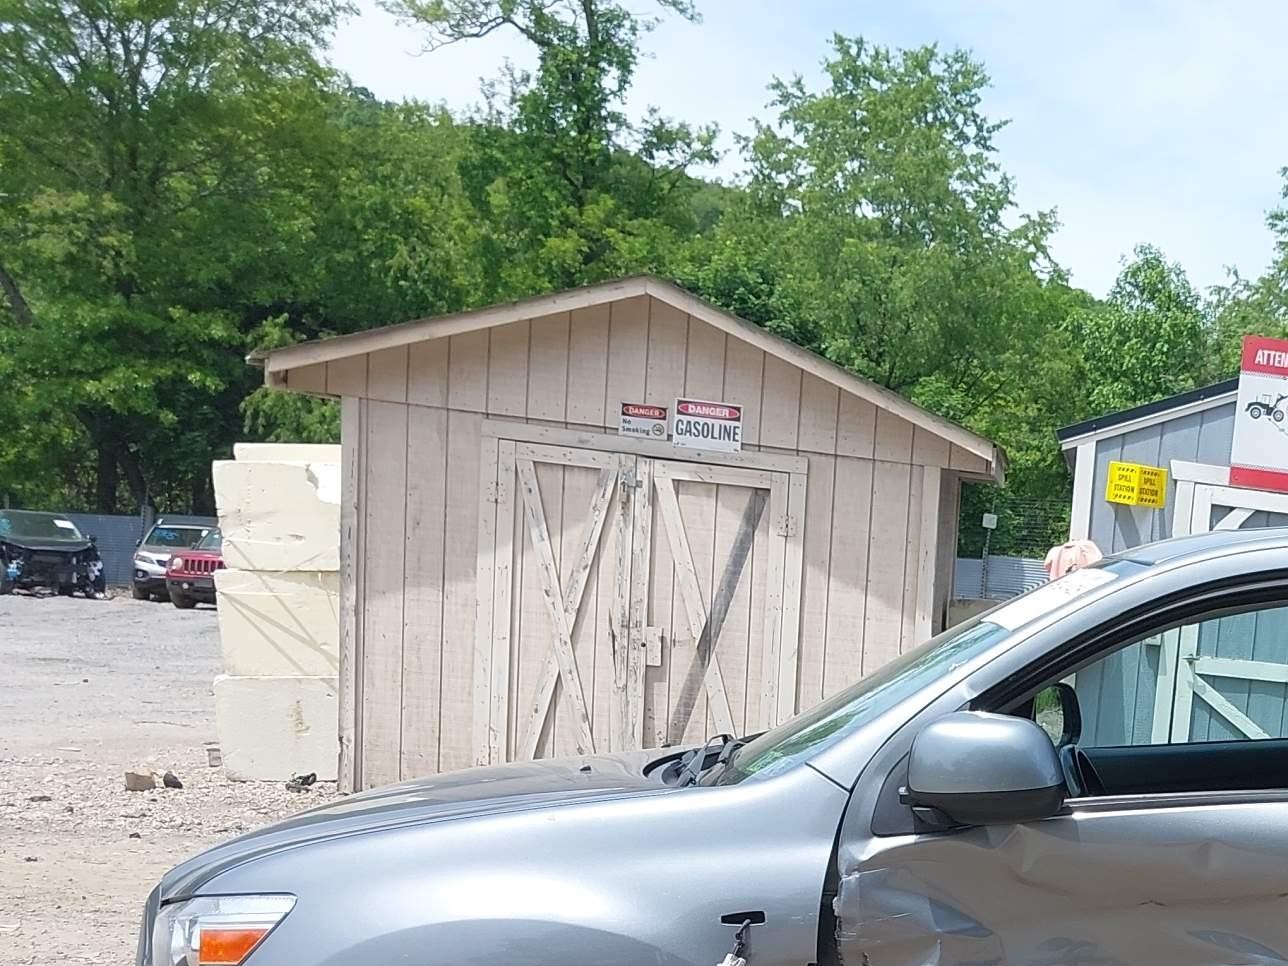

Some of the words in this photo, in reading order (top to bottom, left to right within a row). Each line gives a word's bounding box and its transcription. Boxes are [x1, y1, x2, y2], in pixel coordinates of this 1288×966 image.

[629, 407, 660, 416] DANGER
[688, 404, 729, 417] DANGER
[622, 426, 650, 436] Smoking
[675, 419, 740, 442] GASOLINE
